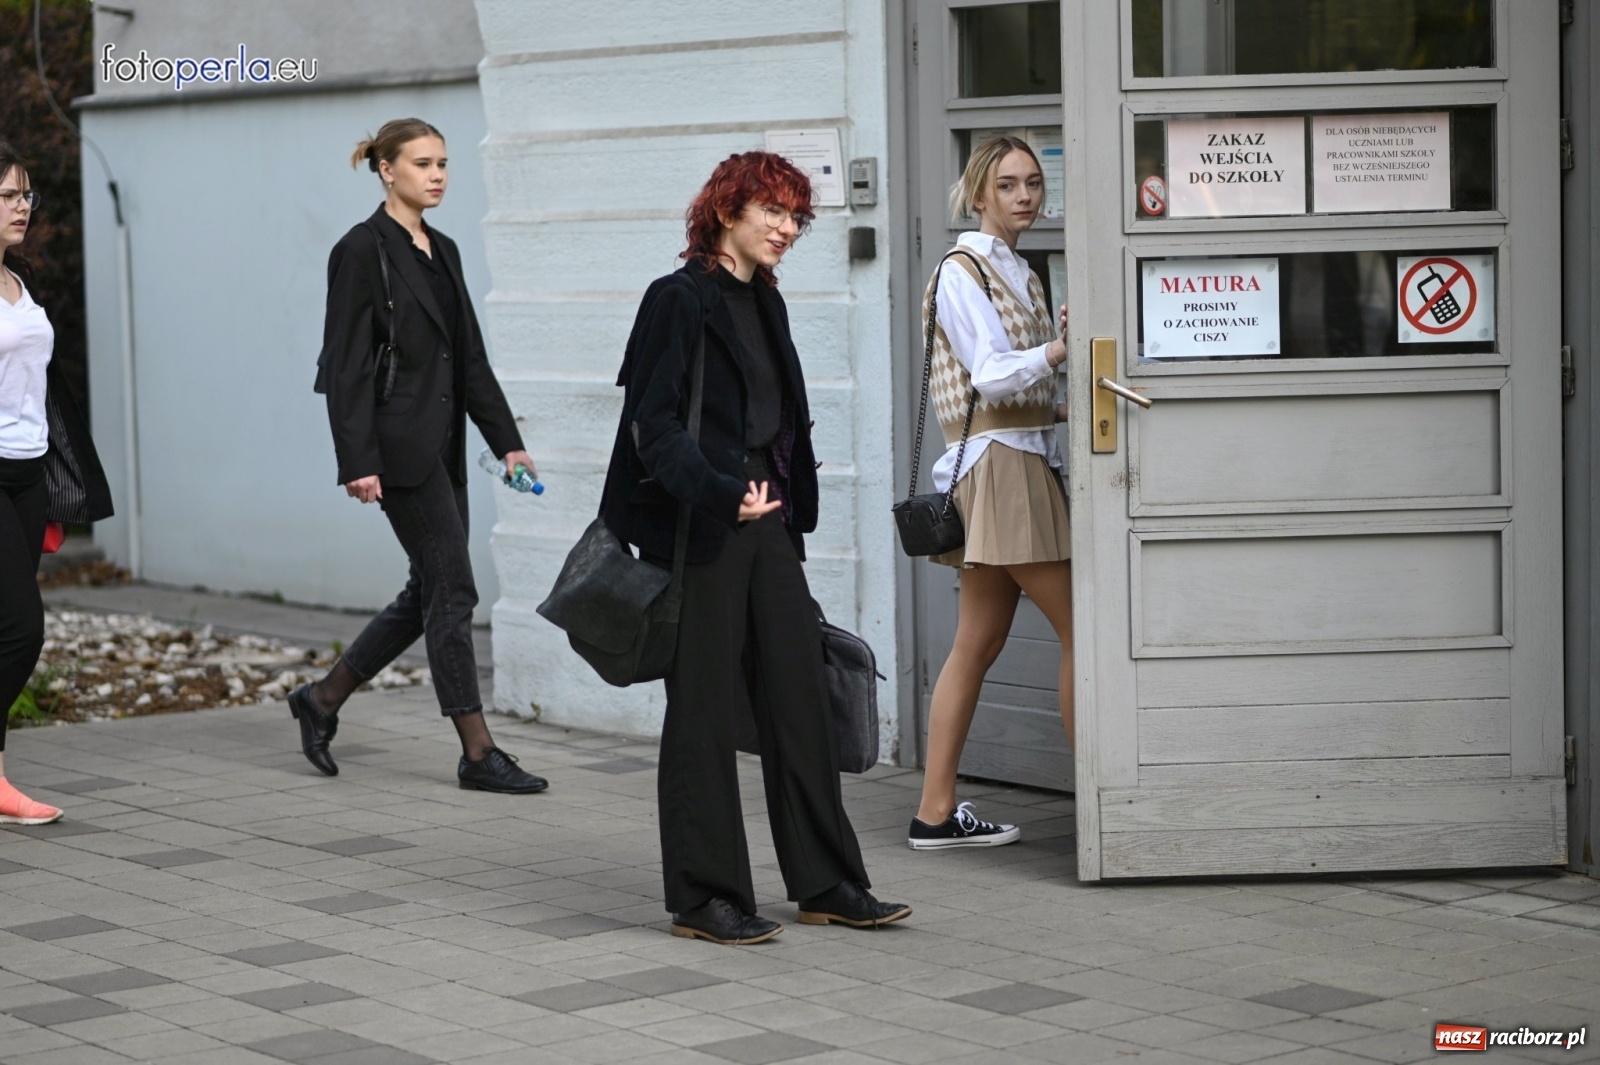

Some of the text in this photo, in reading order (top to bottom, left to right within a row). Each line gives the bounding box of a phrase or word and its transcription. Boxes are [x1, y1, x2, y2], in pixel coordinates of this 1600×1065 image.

[1326, 125, 1437, 136] DLA OSÓB NIEBĘDĄCYCH
[1207, 133, 1266, 147] ZAKAZ
[1348, 138, 1414, 147] UCZNIAMI LUB
[1199, 148, 1274, 165] WEJŚCIA
[1326, 149, 1436, 160] PRACOWNIKAMI SZKOŁY
[1333, 161, 1430, 171] BEZ WCZEŚNIEJSZEGO
[1189, 170, 1285, 184] DO SZKOŁY
[1335, 173, 1429, 183] USTALENIA TERMINU
[1160, 275, 1262, 294] MATURA
[1183, 302, 1238, 312] PROSIMY
[1163, 317, 1259, 329] O ZACHOWANIE
[1193, 332, 1229, 343] CISZY
